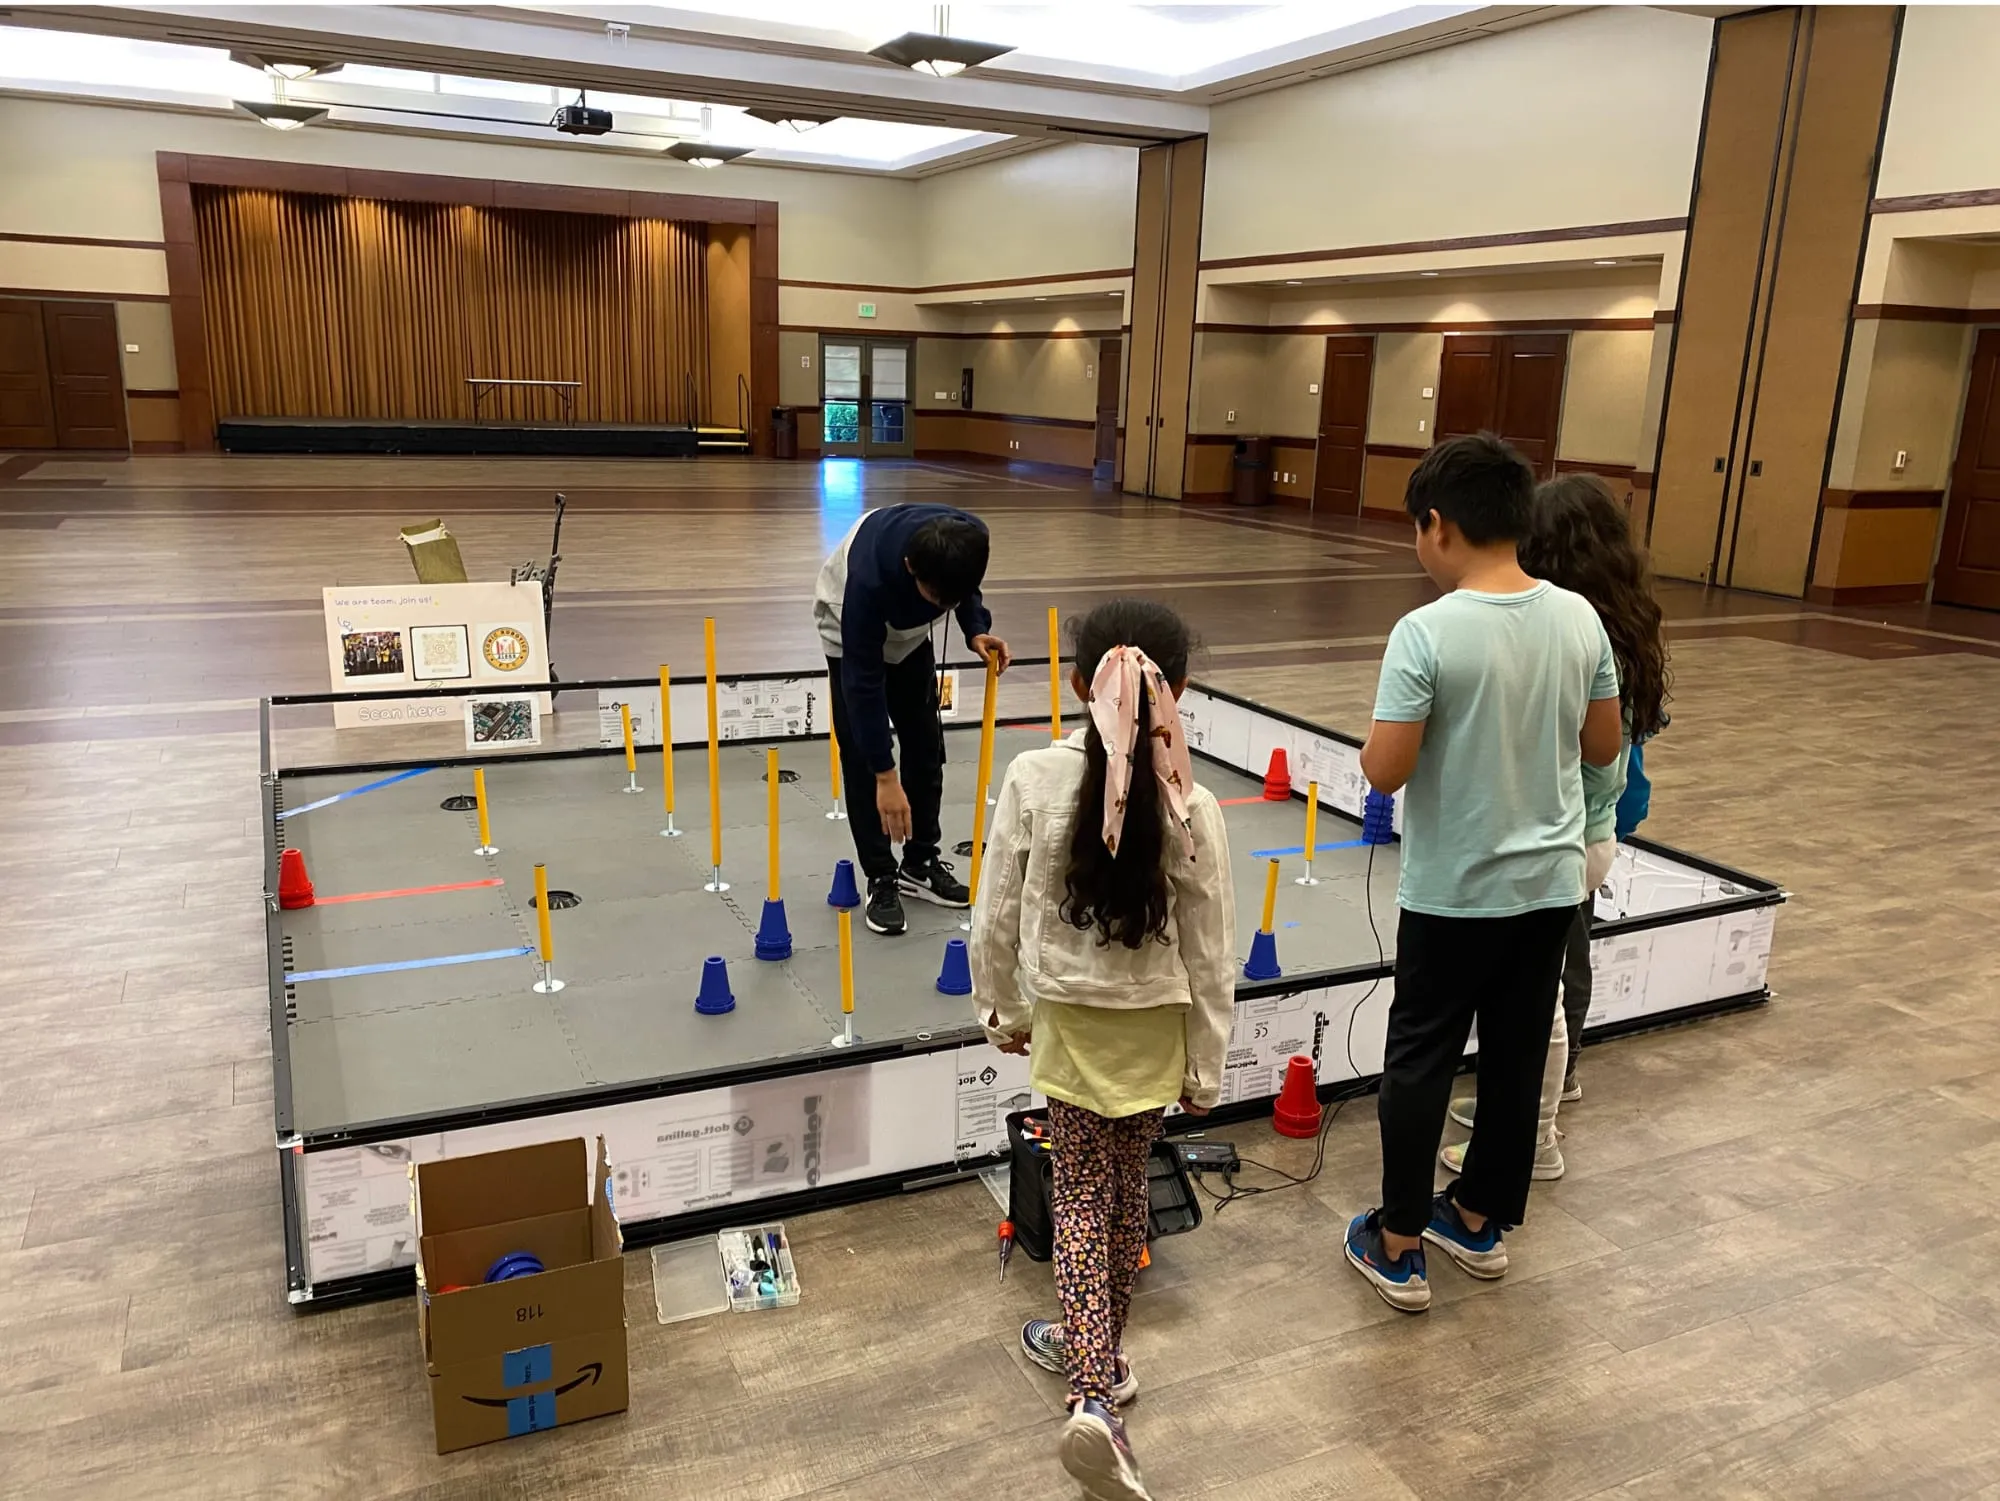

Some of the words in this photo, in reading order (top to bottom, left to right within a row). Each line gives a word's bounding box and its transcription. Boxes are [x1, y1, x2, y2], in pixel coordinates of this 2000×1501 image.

[399, 596, 417, 606] join
[418, 595, 432, 604] us!
[358, 706, 402, 722] Scan
[406, 703, 448, 719] here
[1254, 1026, 1269, 1039] CE
[516, 1303, 545, 1322] 118
